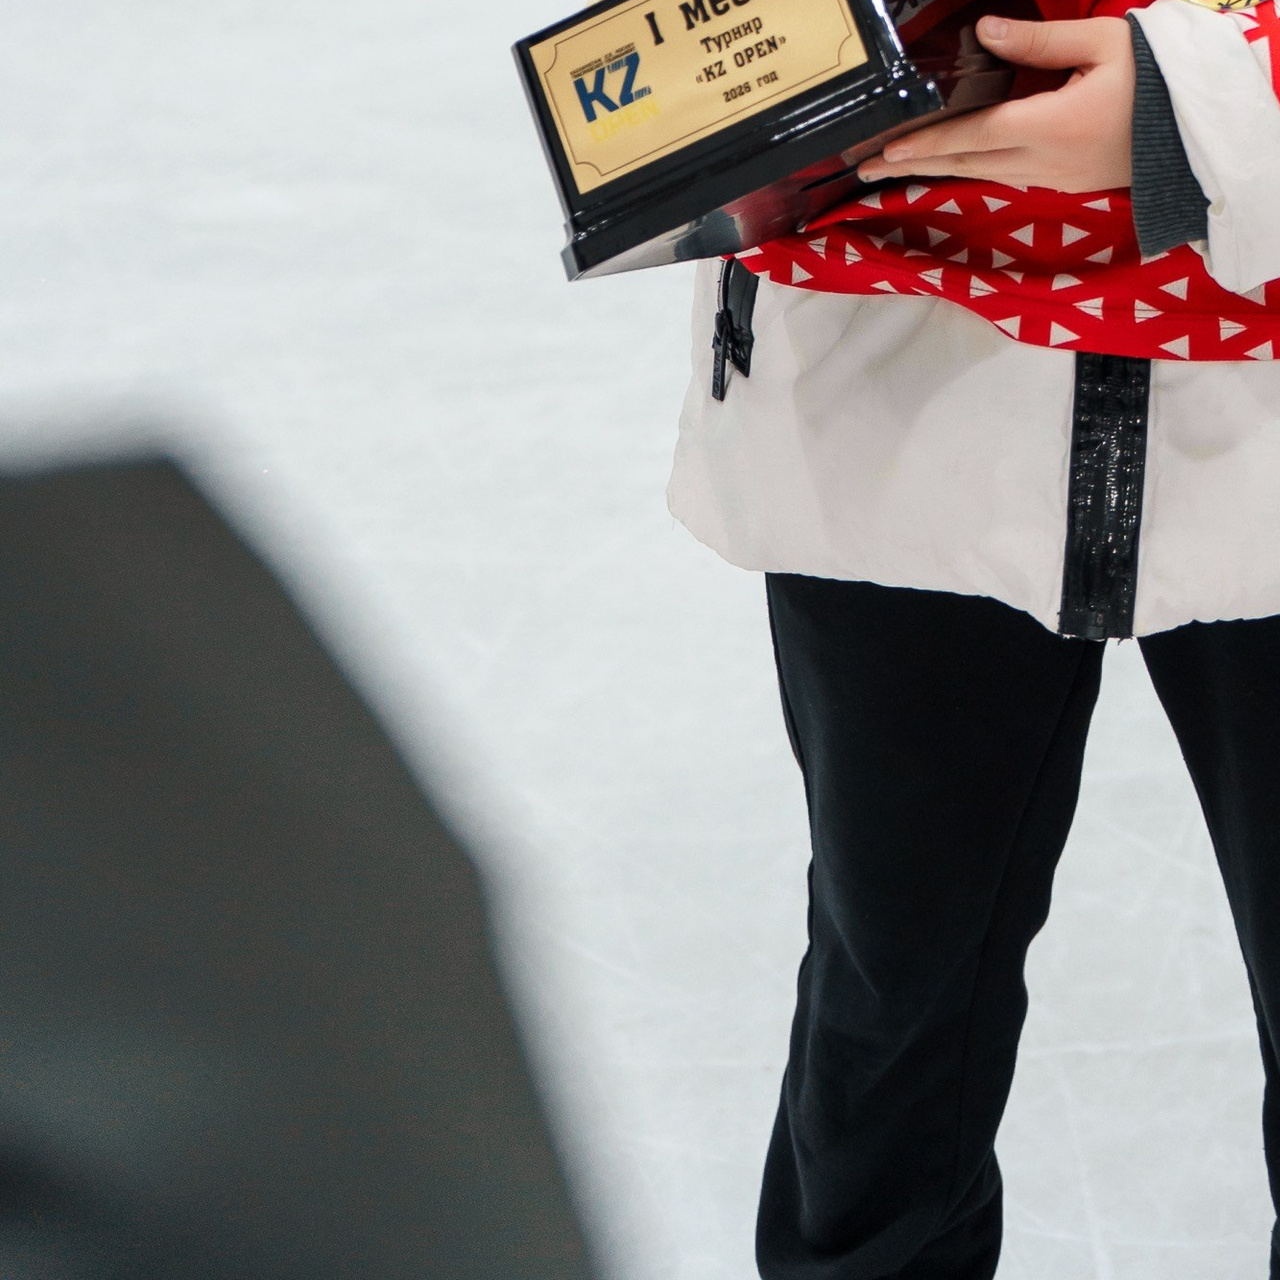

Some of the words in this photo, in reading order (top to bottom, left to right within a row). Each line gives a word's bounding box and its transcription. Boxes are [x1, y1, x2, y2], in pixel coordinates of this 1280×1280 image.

[700, 17, 763, 53] Турнир
[573, 51, 652, 123] KZ
[722, 81, 752, 103] 2026
[756, 70, 779, 87] год
[589, 96, 659, 144] OPEN
